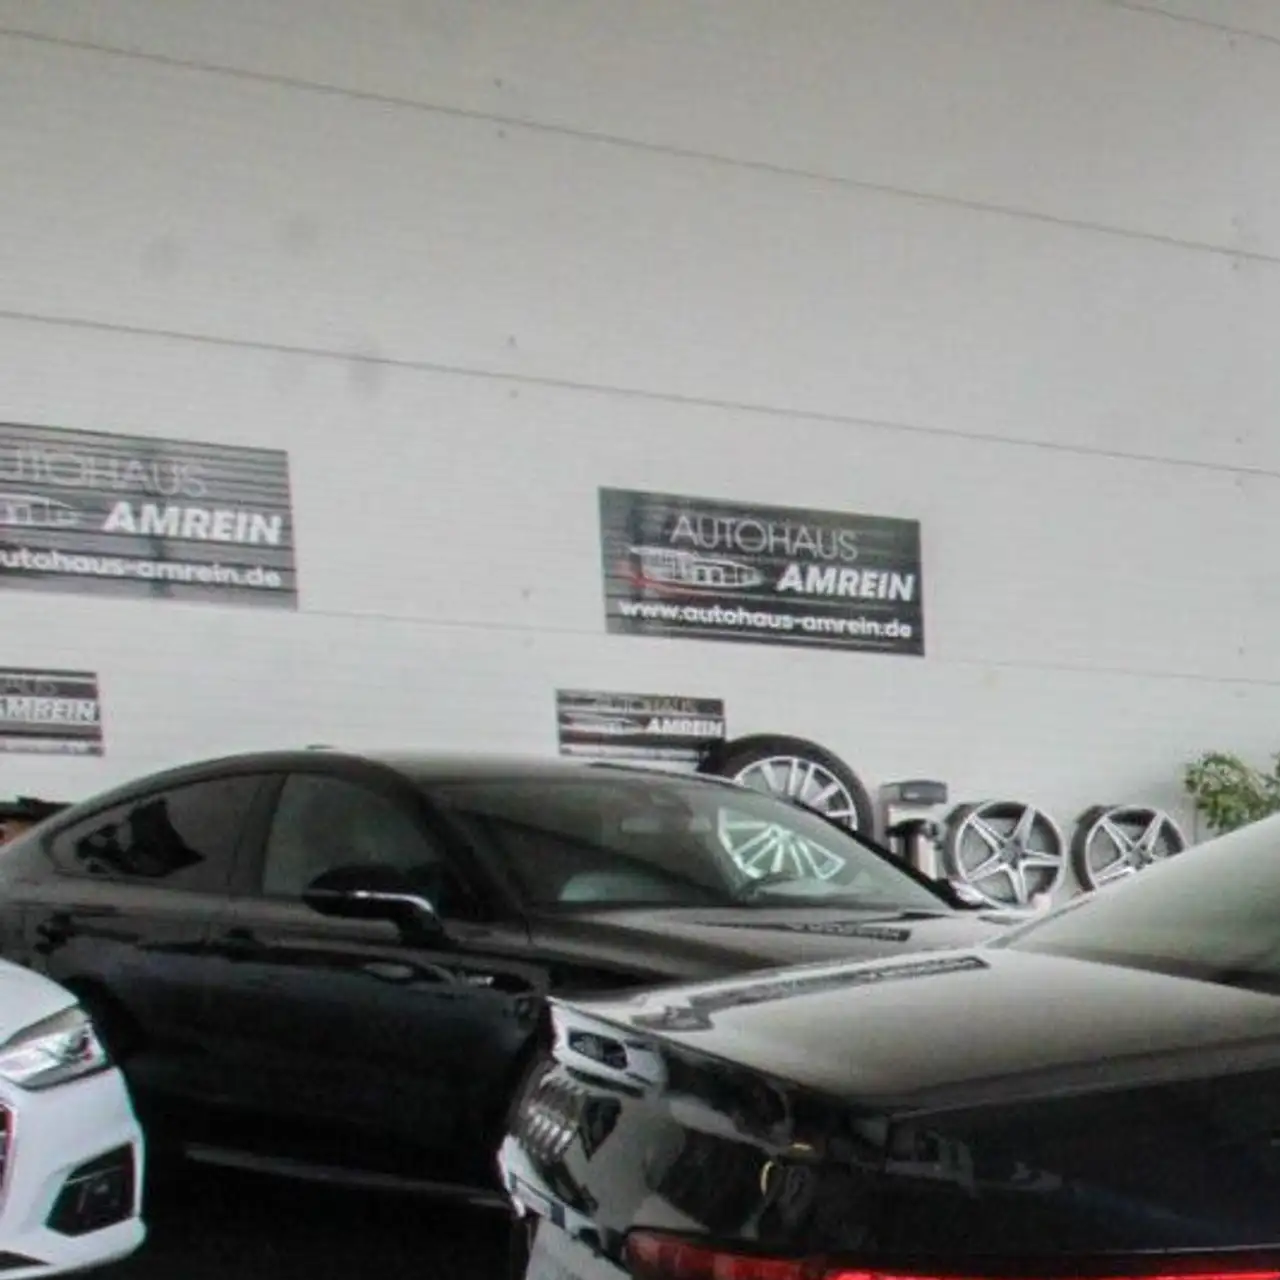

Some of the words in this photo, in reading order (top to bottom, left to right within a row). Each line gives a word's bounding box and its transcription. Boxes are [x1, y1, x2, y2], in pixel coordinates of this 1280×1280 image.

[0, 448, 206, 496] UTOHAUS
[103, 501, 281, 544] AMREIN
[670, 515, 858, 561] AUTOHAUS
[0, 549, 281, 587] utohaus-amrein.de
[776, 564, 915, 602] AMREIN
[619, 602, 912, 638] www.autohaus-amrein.de
